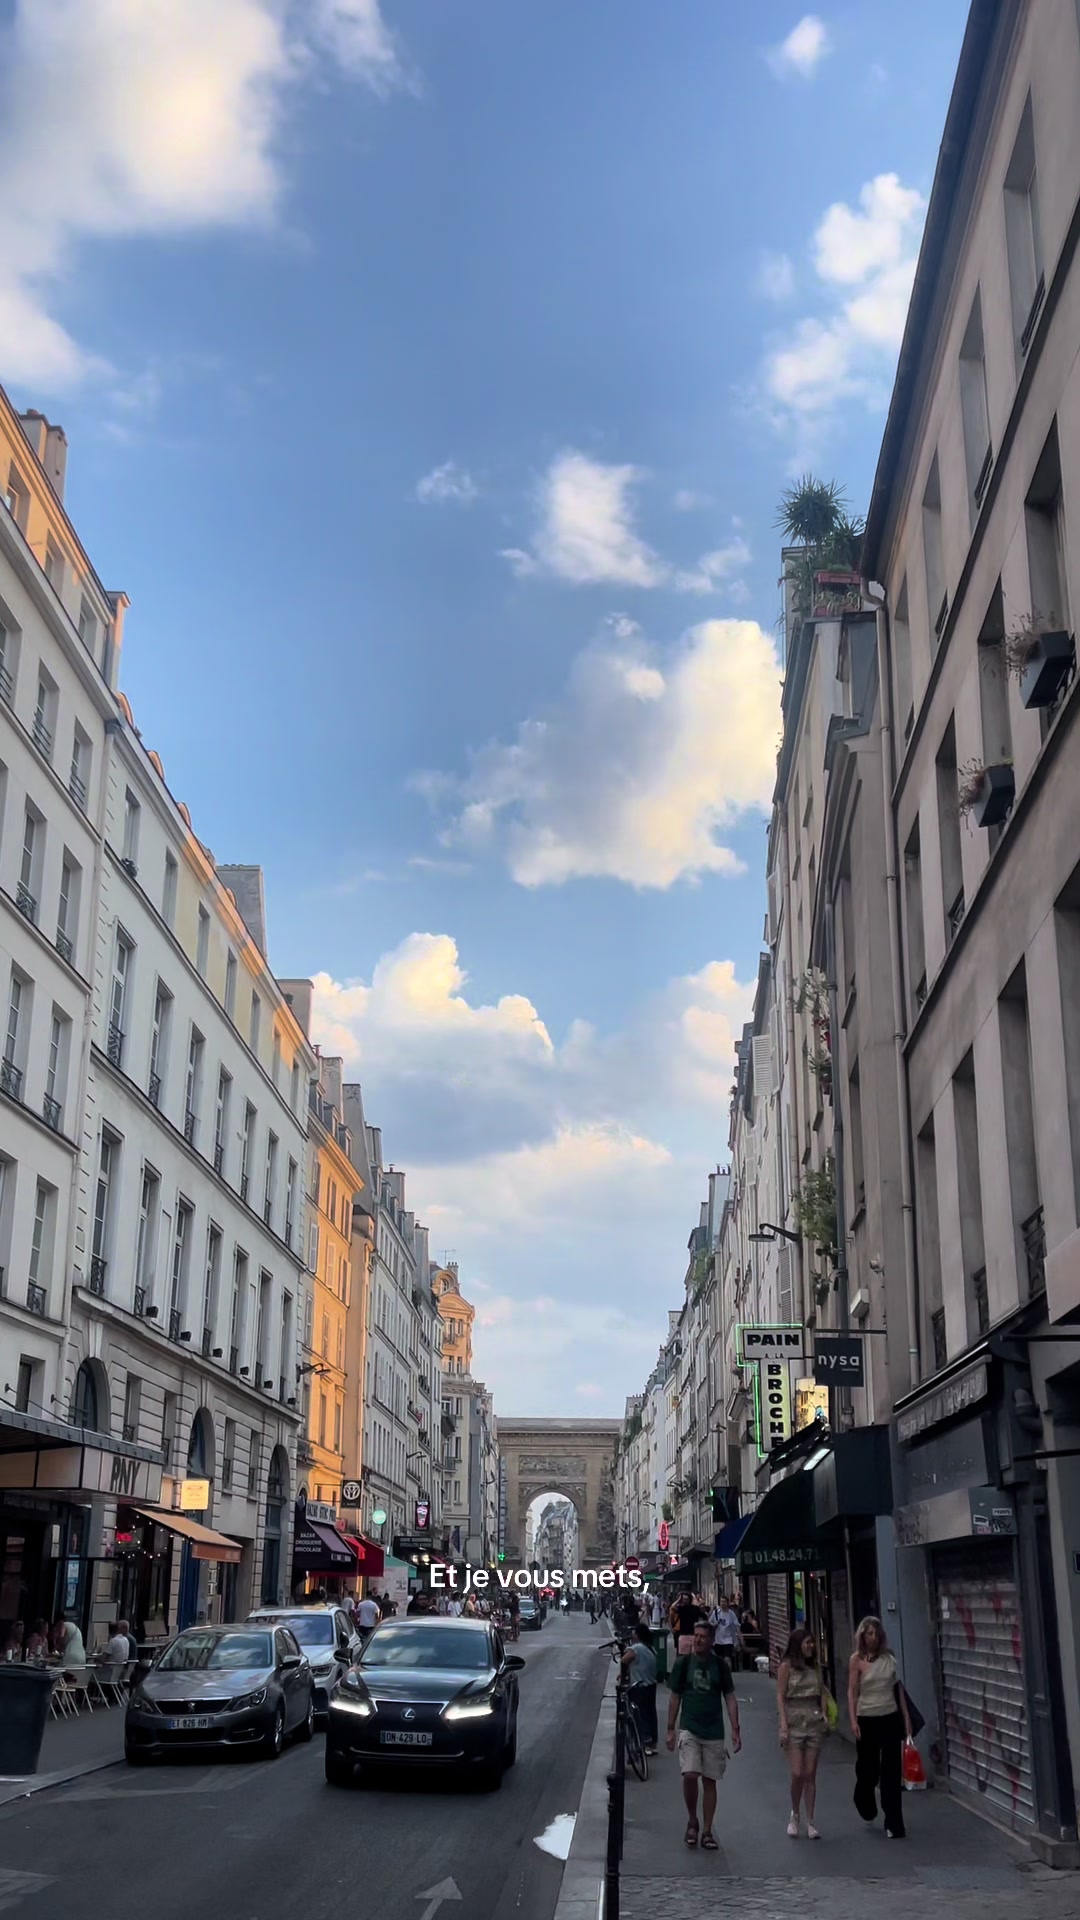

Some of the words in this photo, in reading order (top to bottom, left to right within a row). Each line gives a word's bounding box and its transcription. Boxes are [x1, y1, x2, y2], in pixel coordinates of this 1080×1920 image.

[747, 1334, 800, 1346] PAIN
[818, 1354, 860, 1368] nysa
[767, 1364, 785, 1448] BROCHE
[110, 1456, 141, 1496] PNY
